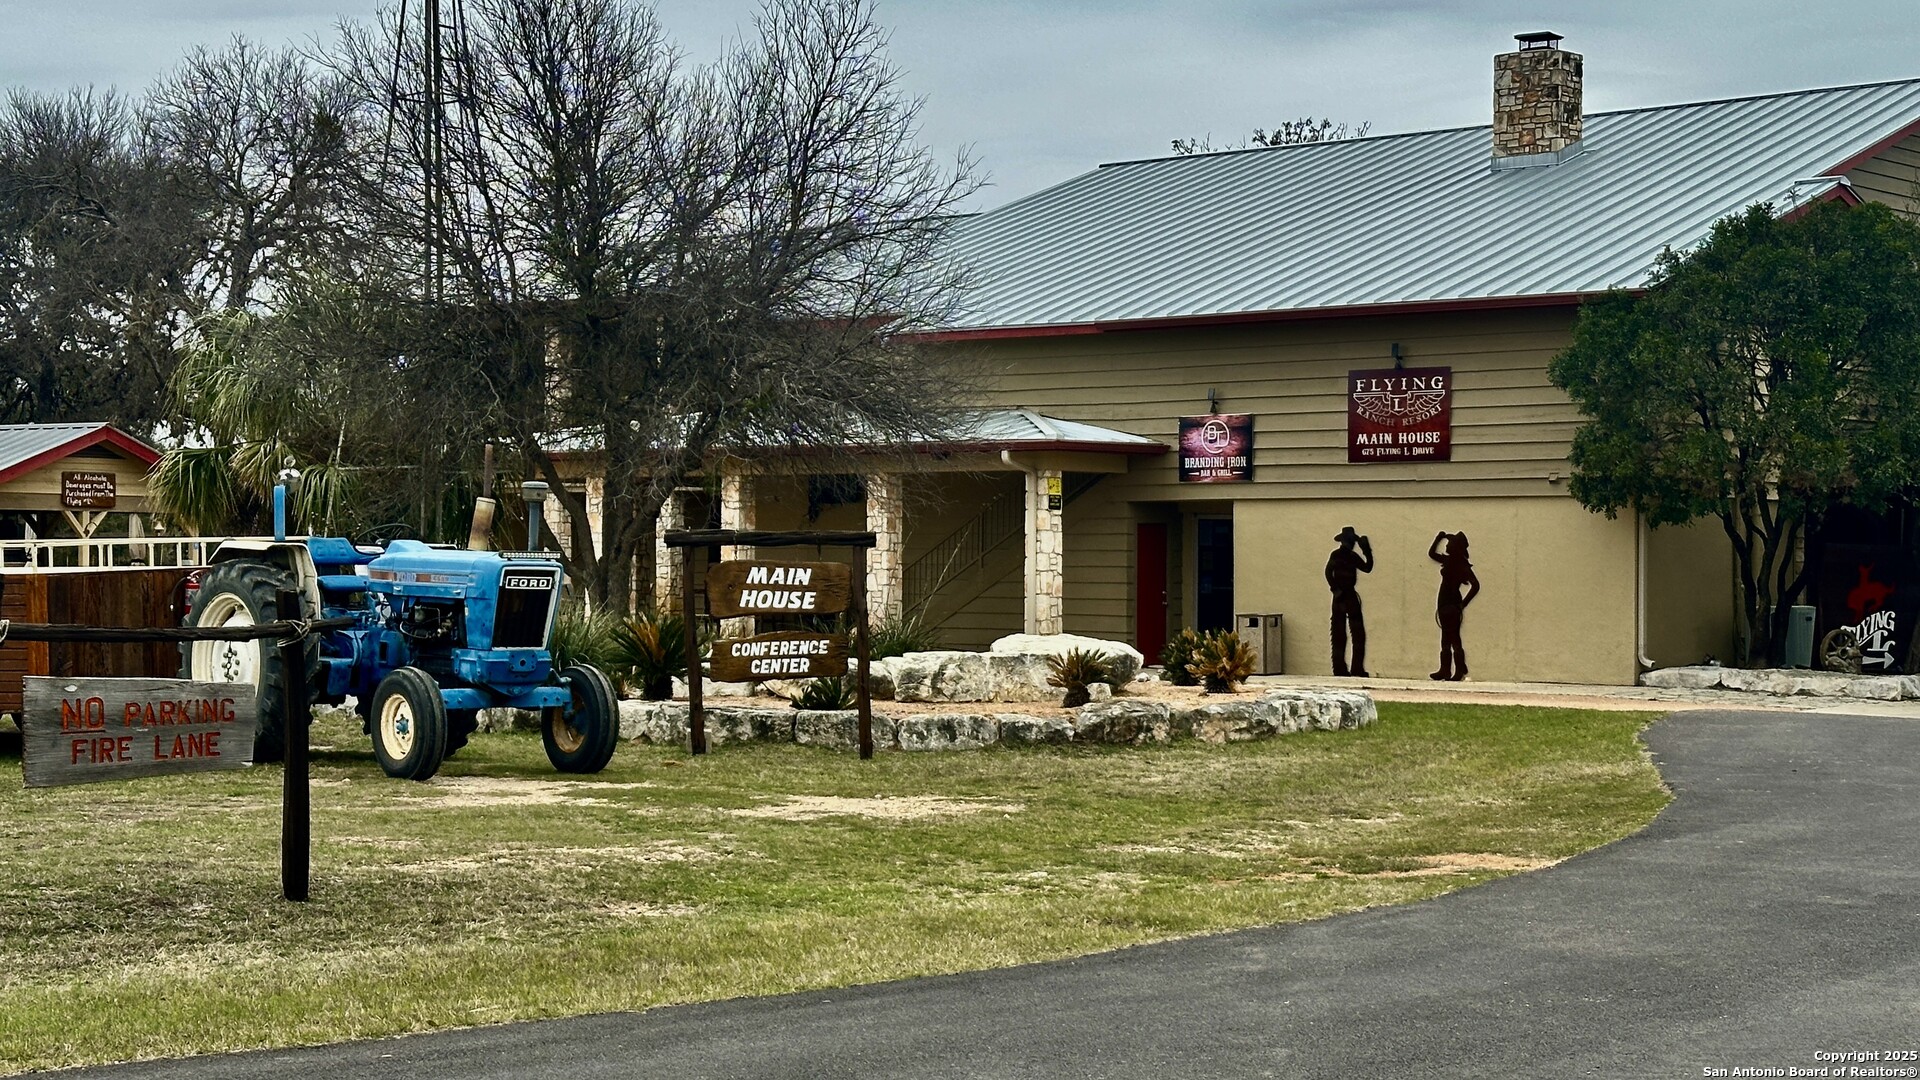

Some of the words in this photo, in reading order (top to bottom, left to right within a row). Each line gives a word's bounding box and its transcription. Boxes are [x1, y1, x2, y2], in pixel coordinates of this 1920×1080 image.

[1355, 376, 1444, 392] FLYING
[1393, 398, 1405, 411] L
[1356, 405, 1395, 426] RANCH
[1402, 403, 1442, 426] RESORT
[1356, 433, 1392, 445] MAIN
[1398, 431, 1440, 444] HOUSE
[1404, 447, 1410, 455] L
[1185, 457, 1224, 468] BRANDING
[1227, 456, 1246, 468] IRON
[1200, 469, 1210, 477] BAR
[510, 578, 548, 587] FORD
[745, 566, 812, 586] MAIN
[739, 590, 817, 609] HOUSE
[731, 639, 830, 657] CONFERENCE
[750, 657, 811, 675] CENTER
[60, 696, 105, 730] NO
[124, 697, 236, 727] PARKING
[71, 736, 134, 765] FIRE
[154, 731, 221, 761] LANE
